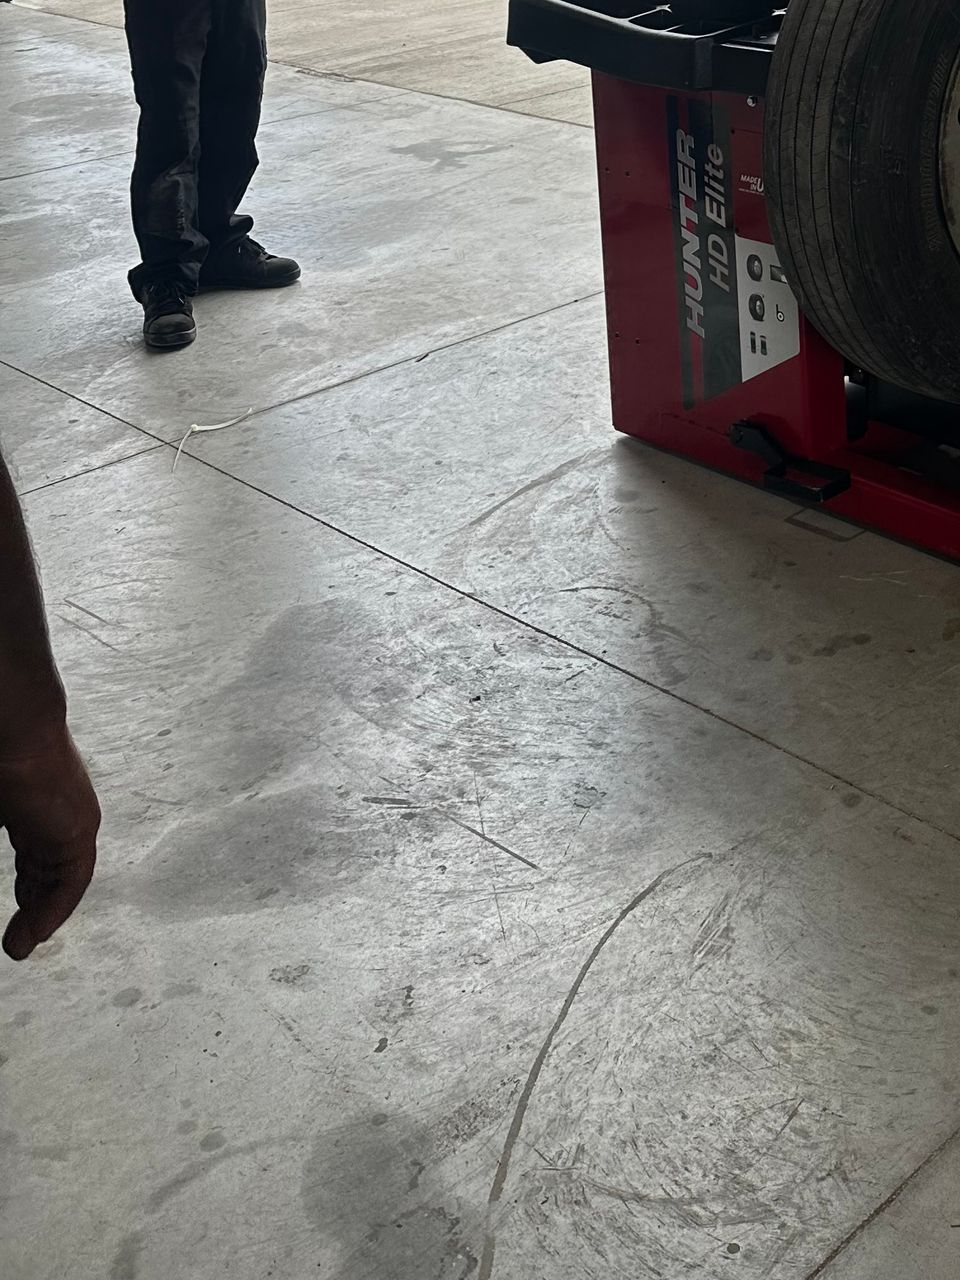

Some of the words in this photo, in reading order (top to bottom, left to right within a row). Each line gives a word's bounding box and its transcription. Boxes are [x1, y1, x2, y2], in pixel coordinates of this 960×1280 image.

[704, 143, 727, 229] Elite
[740, 174, 759, 184] MADE
[749, 183, 757, 191] IN
[675, 127, 706, 339] HUNTER
[707, 232, 730, 293] HD
